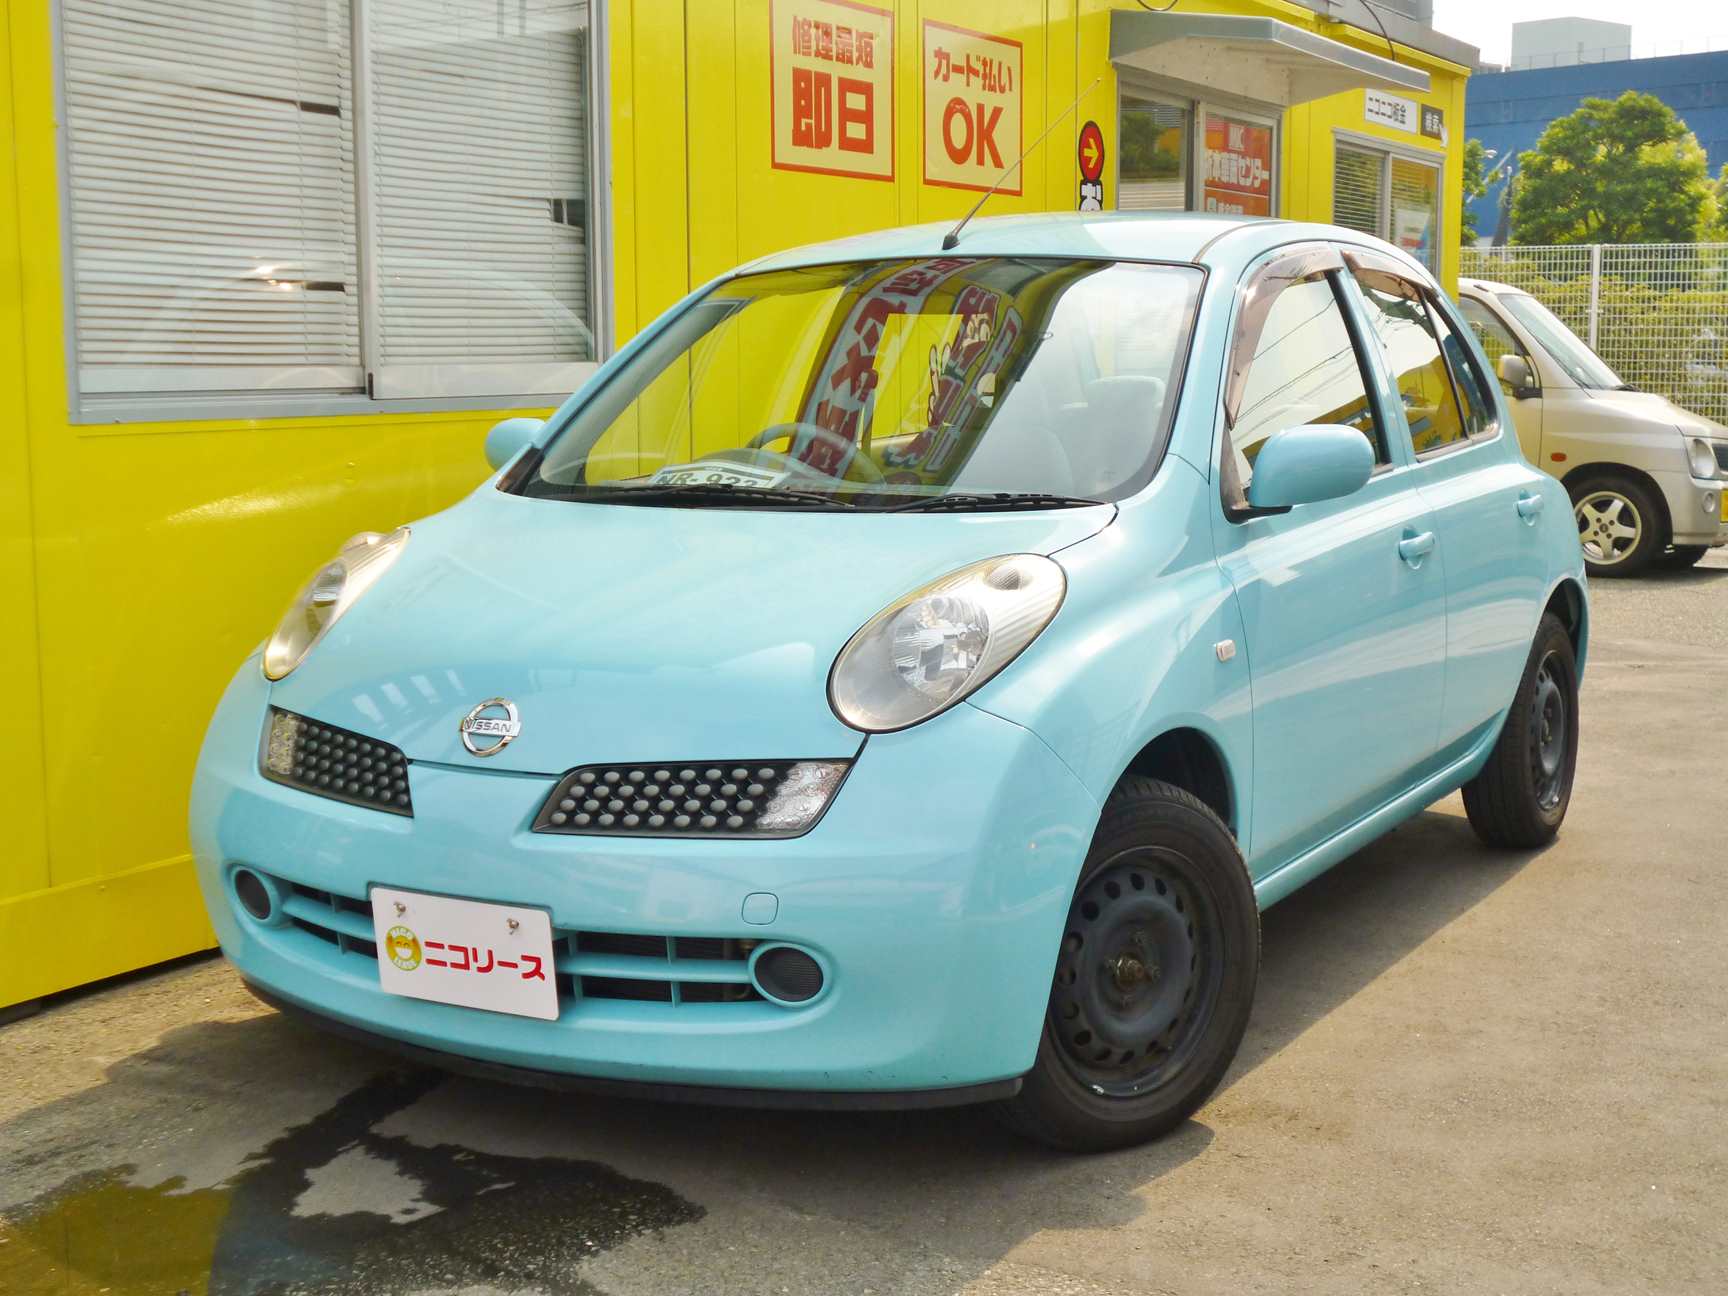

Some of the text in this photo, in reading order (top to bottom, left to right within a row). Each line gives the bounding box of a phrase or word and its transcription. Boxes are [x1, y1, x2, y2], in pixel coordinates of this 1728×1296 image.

[792, 16, 874, 69] 修理最短
[933, 47, 1013, 94] カード払い
[792, 66, 874, 154] 即日
[942, 96, 1005, 170] OK
[464, 718, 512, 733] NISSAN
[424, 940, 546, 981] ニコリース
